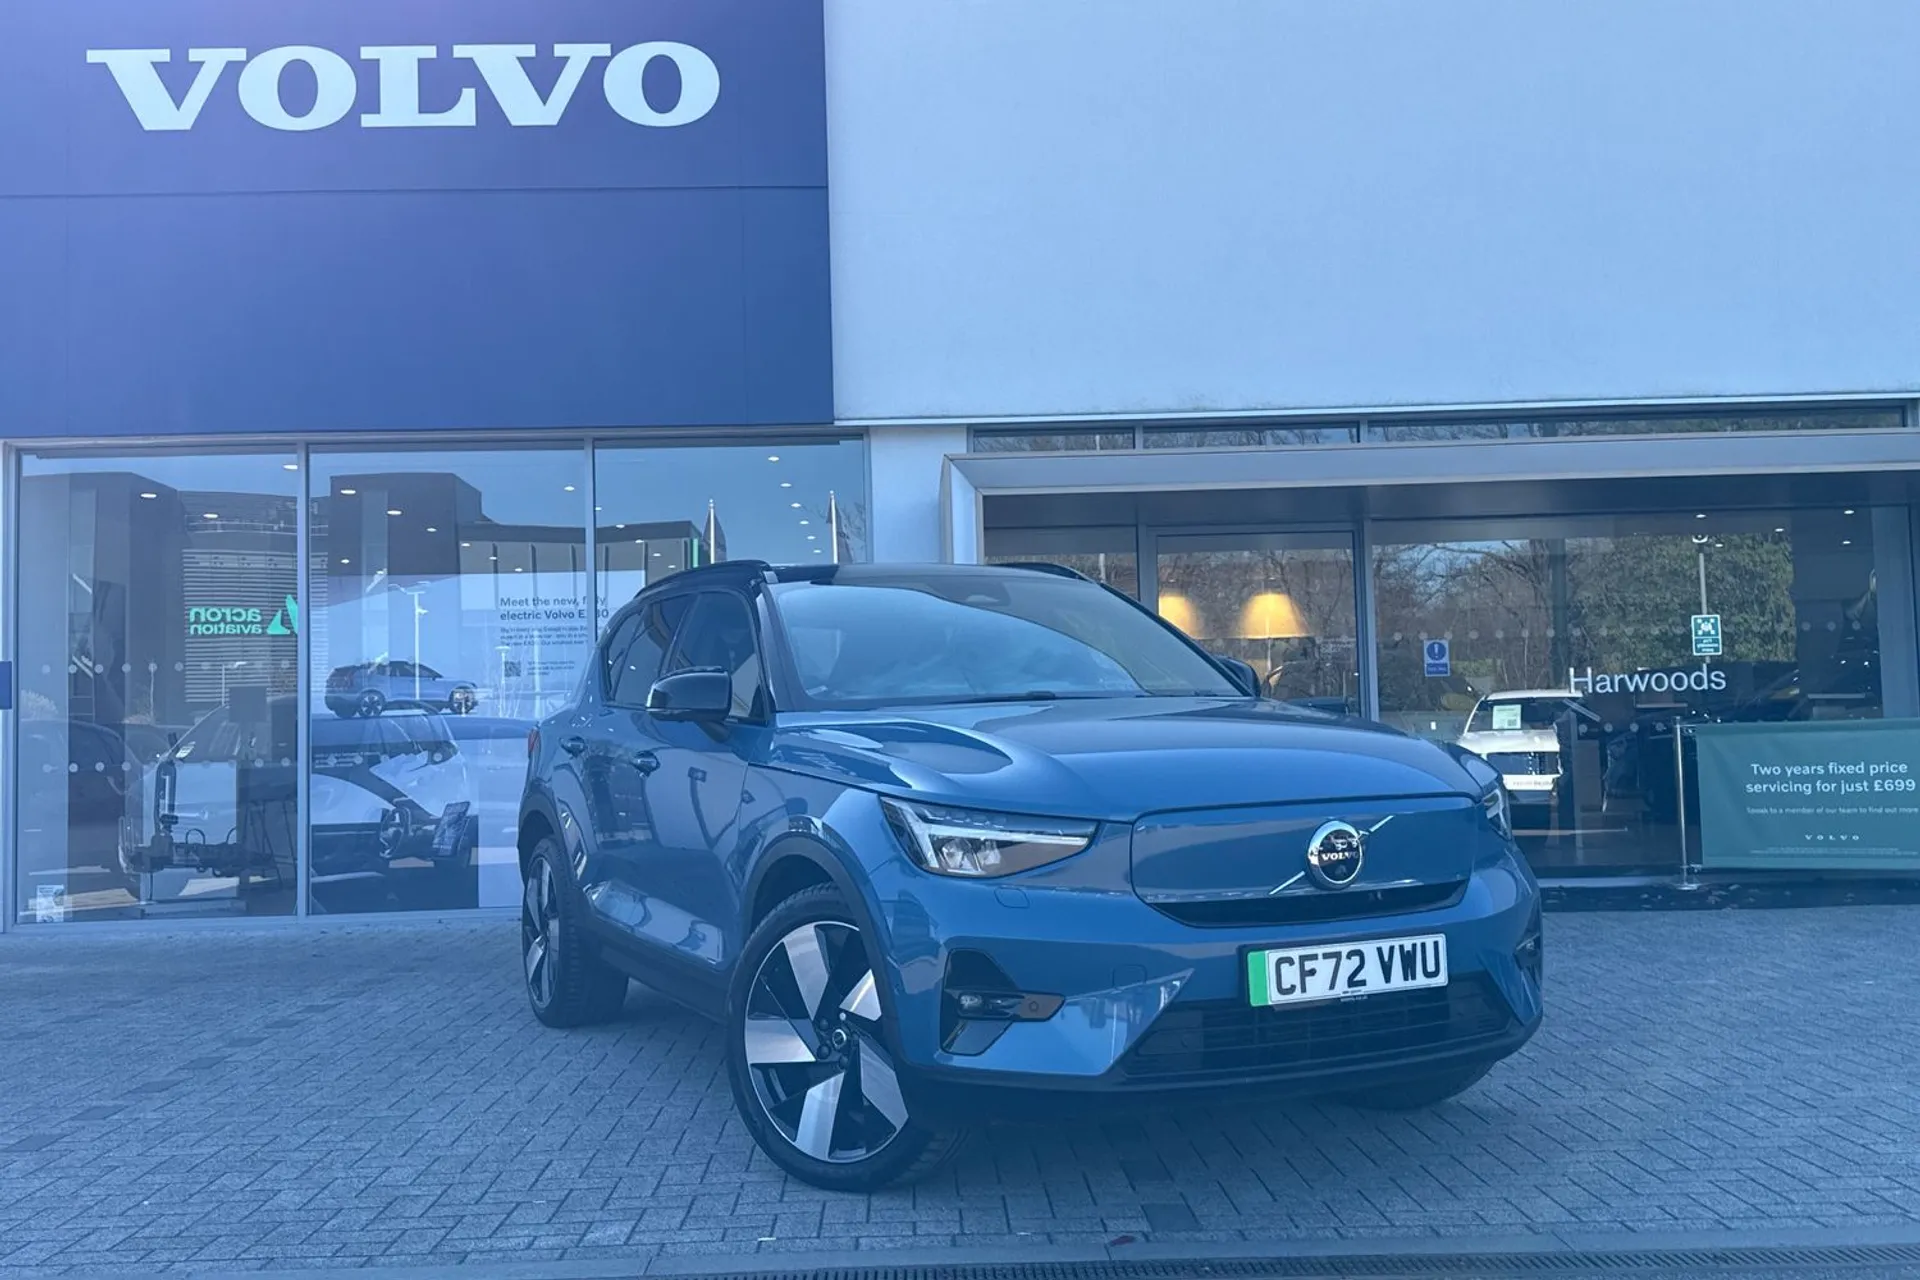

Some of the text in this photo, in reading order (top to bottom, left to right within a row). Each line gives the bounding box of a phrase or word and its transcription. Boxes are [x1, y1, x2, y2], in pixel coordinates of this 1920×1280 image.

[87, 41, 720, 131] VOLVO
[500, 597, 529, 607] Meet
[532, 597, 550, 607] the
[553, 597, 579, 608] new,
[500, 610, 541, 621] electric
[544, 609, 575, 620] Volvo
[1568, 663, 1727, 694] Harwoods
[1751, 761, 1908, 778] Two years fixed price
[1746, 779, 1916, 795] servicing for just £699
[1785, 806, 1814, 814] member
[1868, 805, 1882, 814] find
[1321, 852, 1359, 861] VOLVO
[1274, 940, 1441, 996] CF72 VWU
